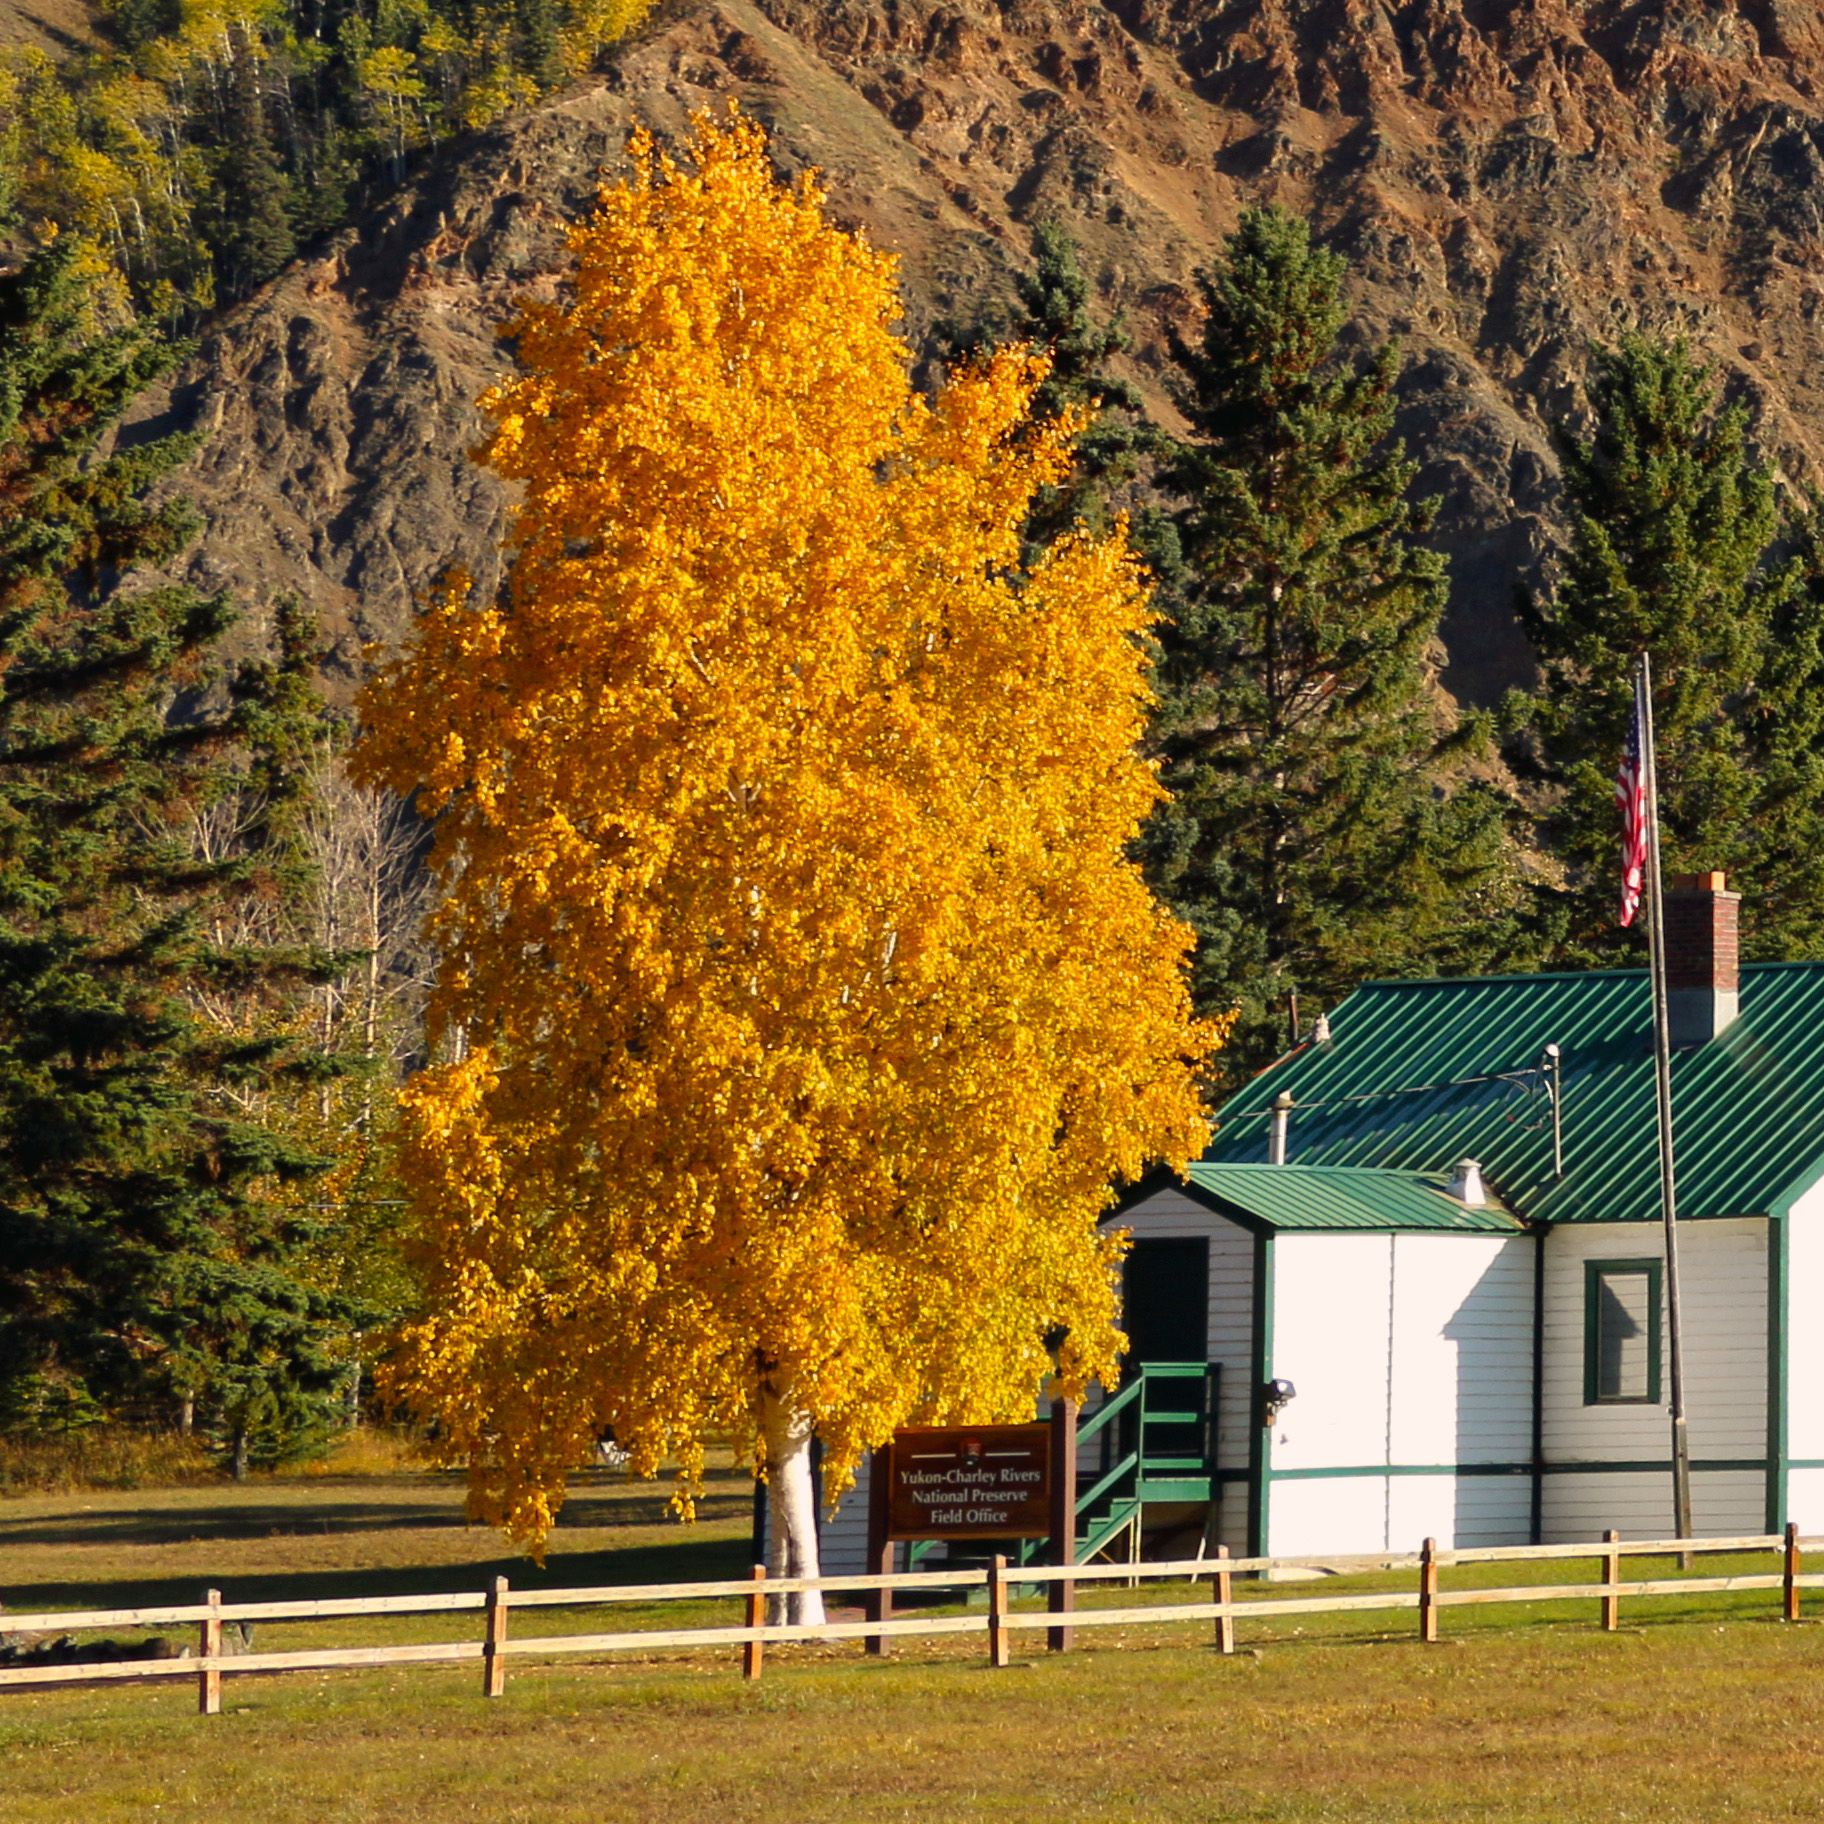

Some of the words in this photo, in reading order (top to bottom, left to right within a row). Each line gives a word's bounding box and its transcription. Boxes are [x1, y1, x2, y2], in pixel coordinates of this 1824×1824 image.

[901, 1469, 996, 1486] Yukon-Charley
[1001, 1468, 1041, 1482] Rivers
[912, 1489, 968, 1503] National
[973, 1488, 1027, 1502] Preserve
[931, 1509, 962, 1523] Field
[966, 1508, 1007, 1522] Office
